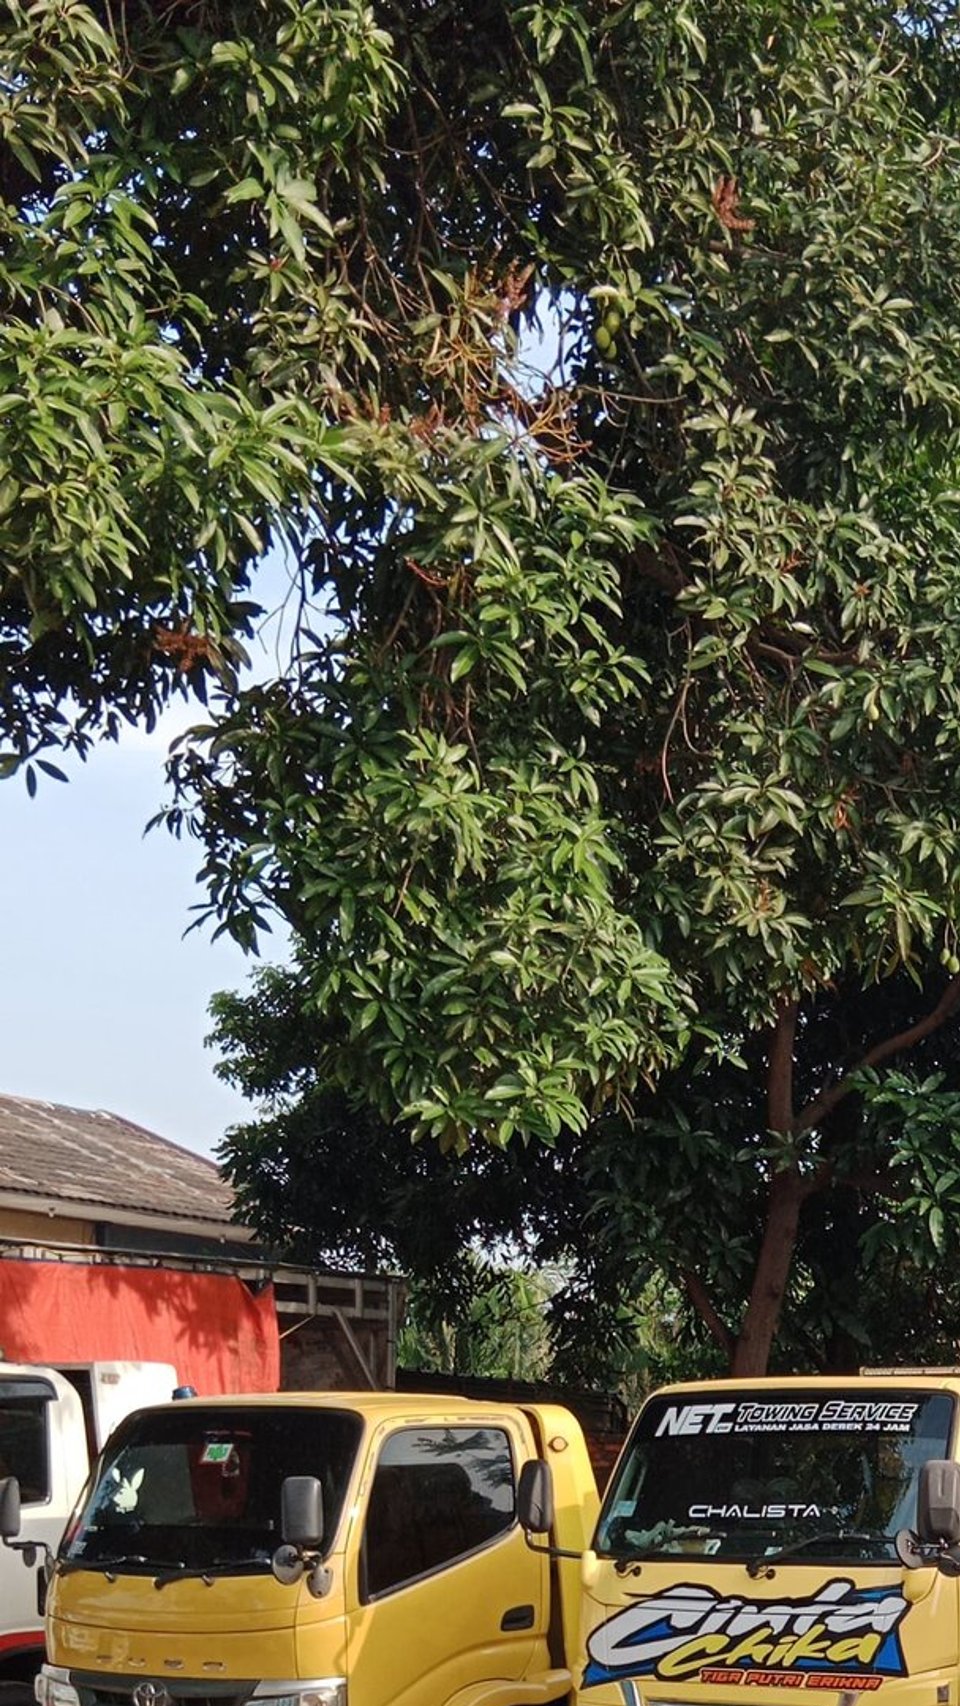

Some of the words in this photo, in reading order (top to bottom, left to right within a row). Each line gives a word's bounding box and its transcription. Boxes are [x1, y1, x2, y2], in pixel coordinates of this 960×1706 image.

[734, 1424, 786, 1432] LAYANAN
[788, 1423, 819, 1431] JASA
[822, 1423, 862, 1431] DEREK
[865, 1423, 880, 1431] 24
[883, 1424, 910, 1432] JAM
[688, 1504, 821, 1518] CHALISTA
[588, 1582, 906, 1666] Cinta
[657, 1624, 882, 1677] Chika
[702, 1671, 741, 1684] TIGA
[746, 1672, 801, 1687] PUTRI
